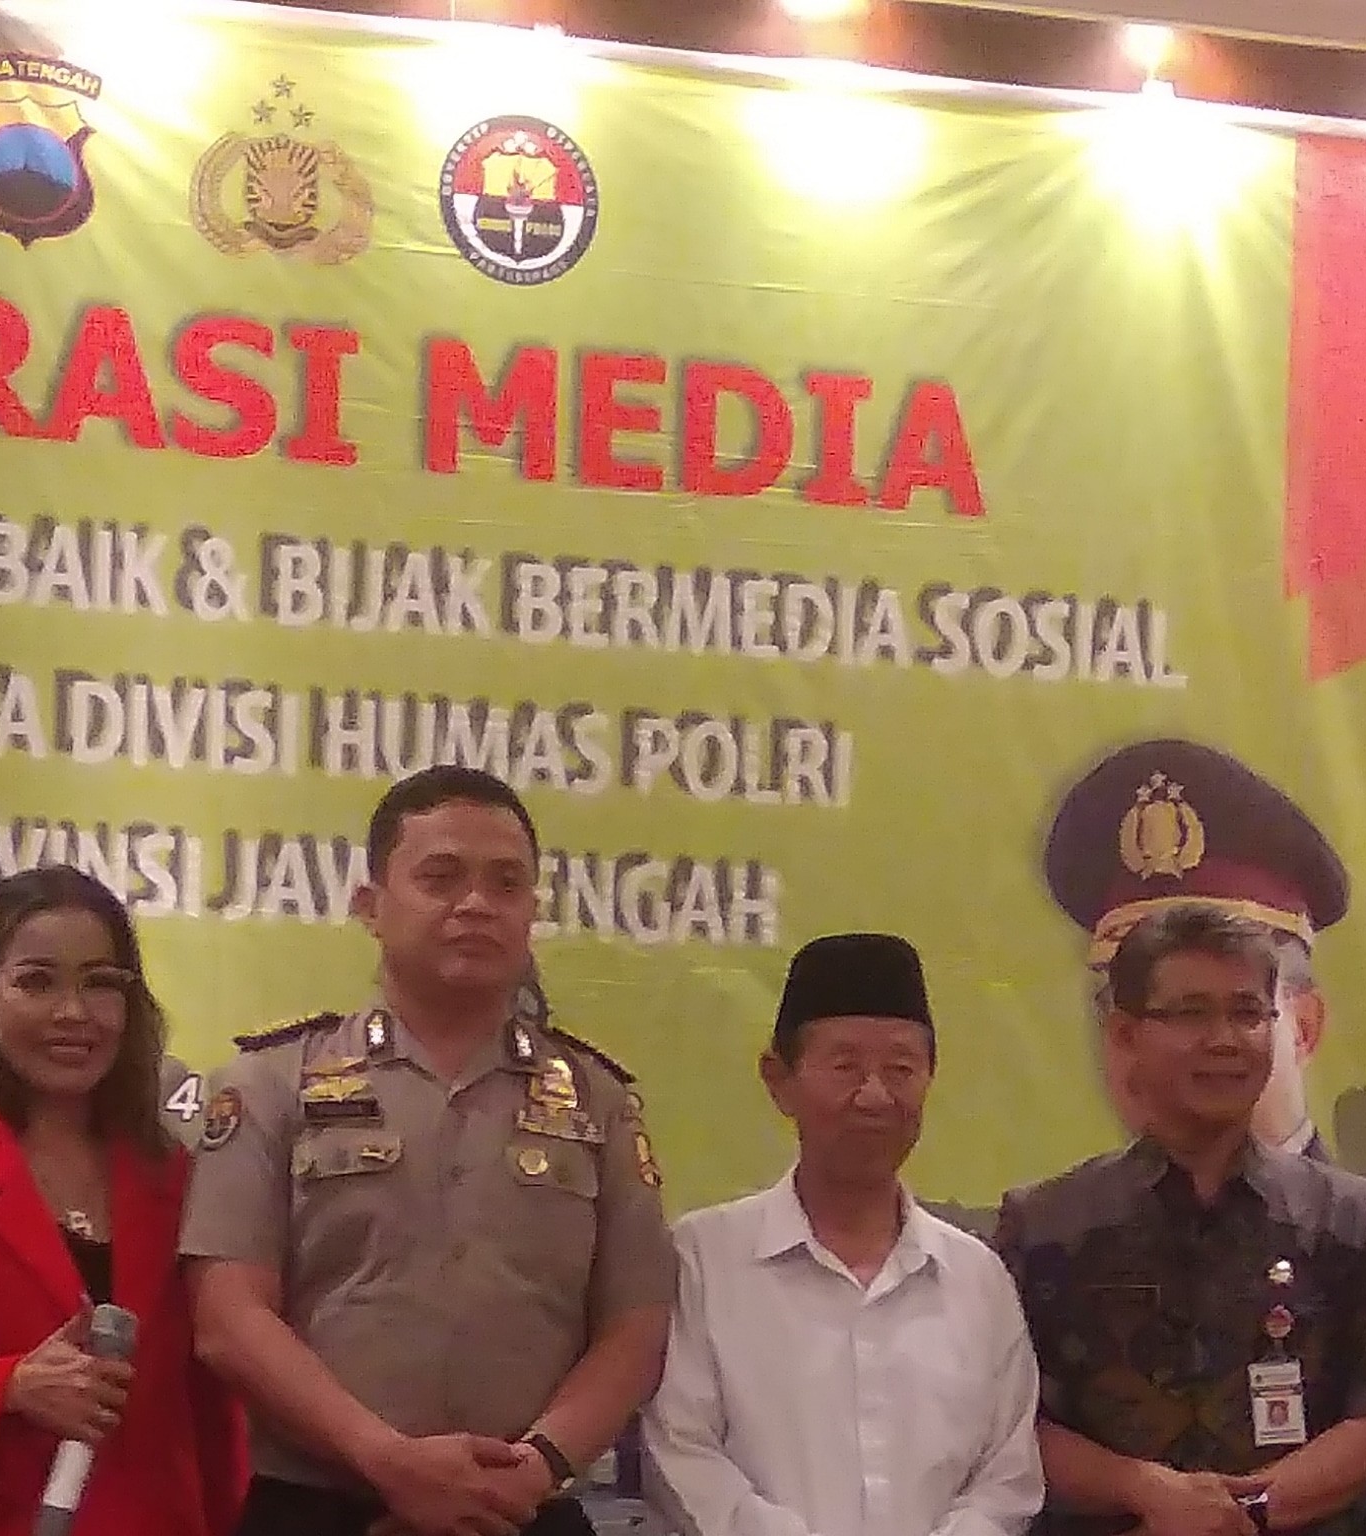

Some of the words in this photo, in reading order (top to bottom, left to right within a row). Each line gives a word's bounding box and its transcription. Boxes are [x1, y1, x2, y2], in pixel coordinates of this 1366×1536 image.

[16, 60, 100, 95] TENGAH
[423, 338, 986, 517] MEDIA
[188, 535, 252, 622] &
[277, 542, 492, 638] BIJAK
[515, 560, 912, 670] BERMEDIA
[928, 590, 1189, 689] SOSIAL
[68, 678, 301, 775] DIVISI
[325, 697, 612, 796] HUMAS
[634, 716, 853, 808] POLRI
[222, 836, 372, 925] JAW
[530, 849, 781, 946] ENGAH
